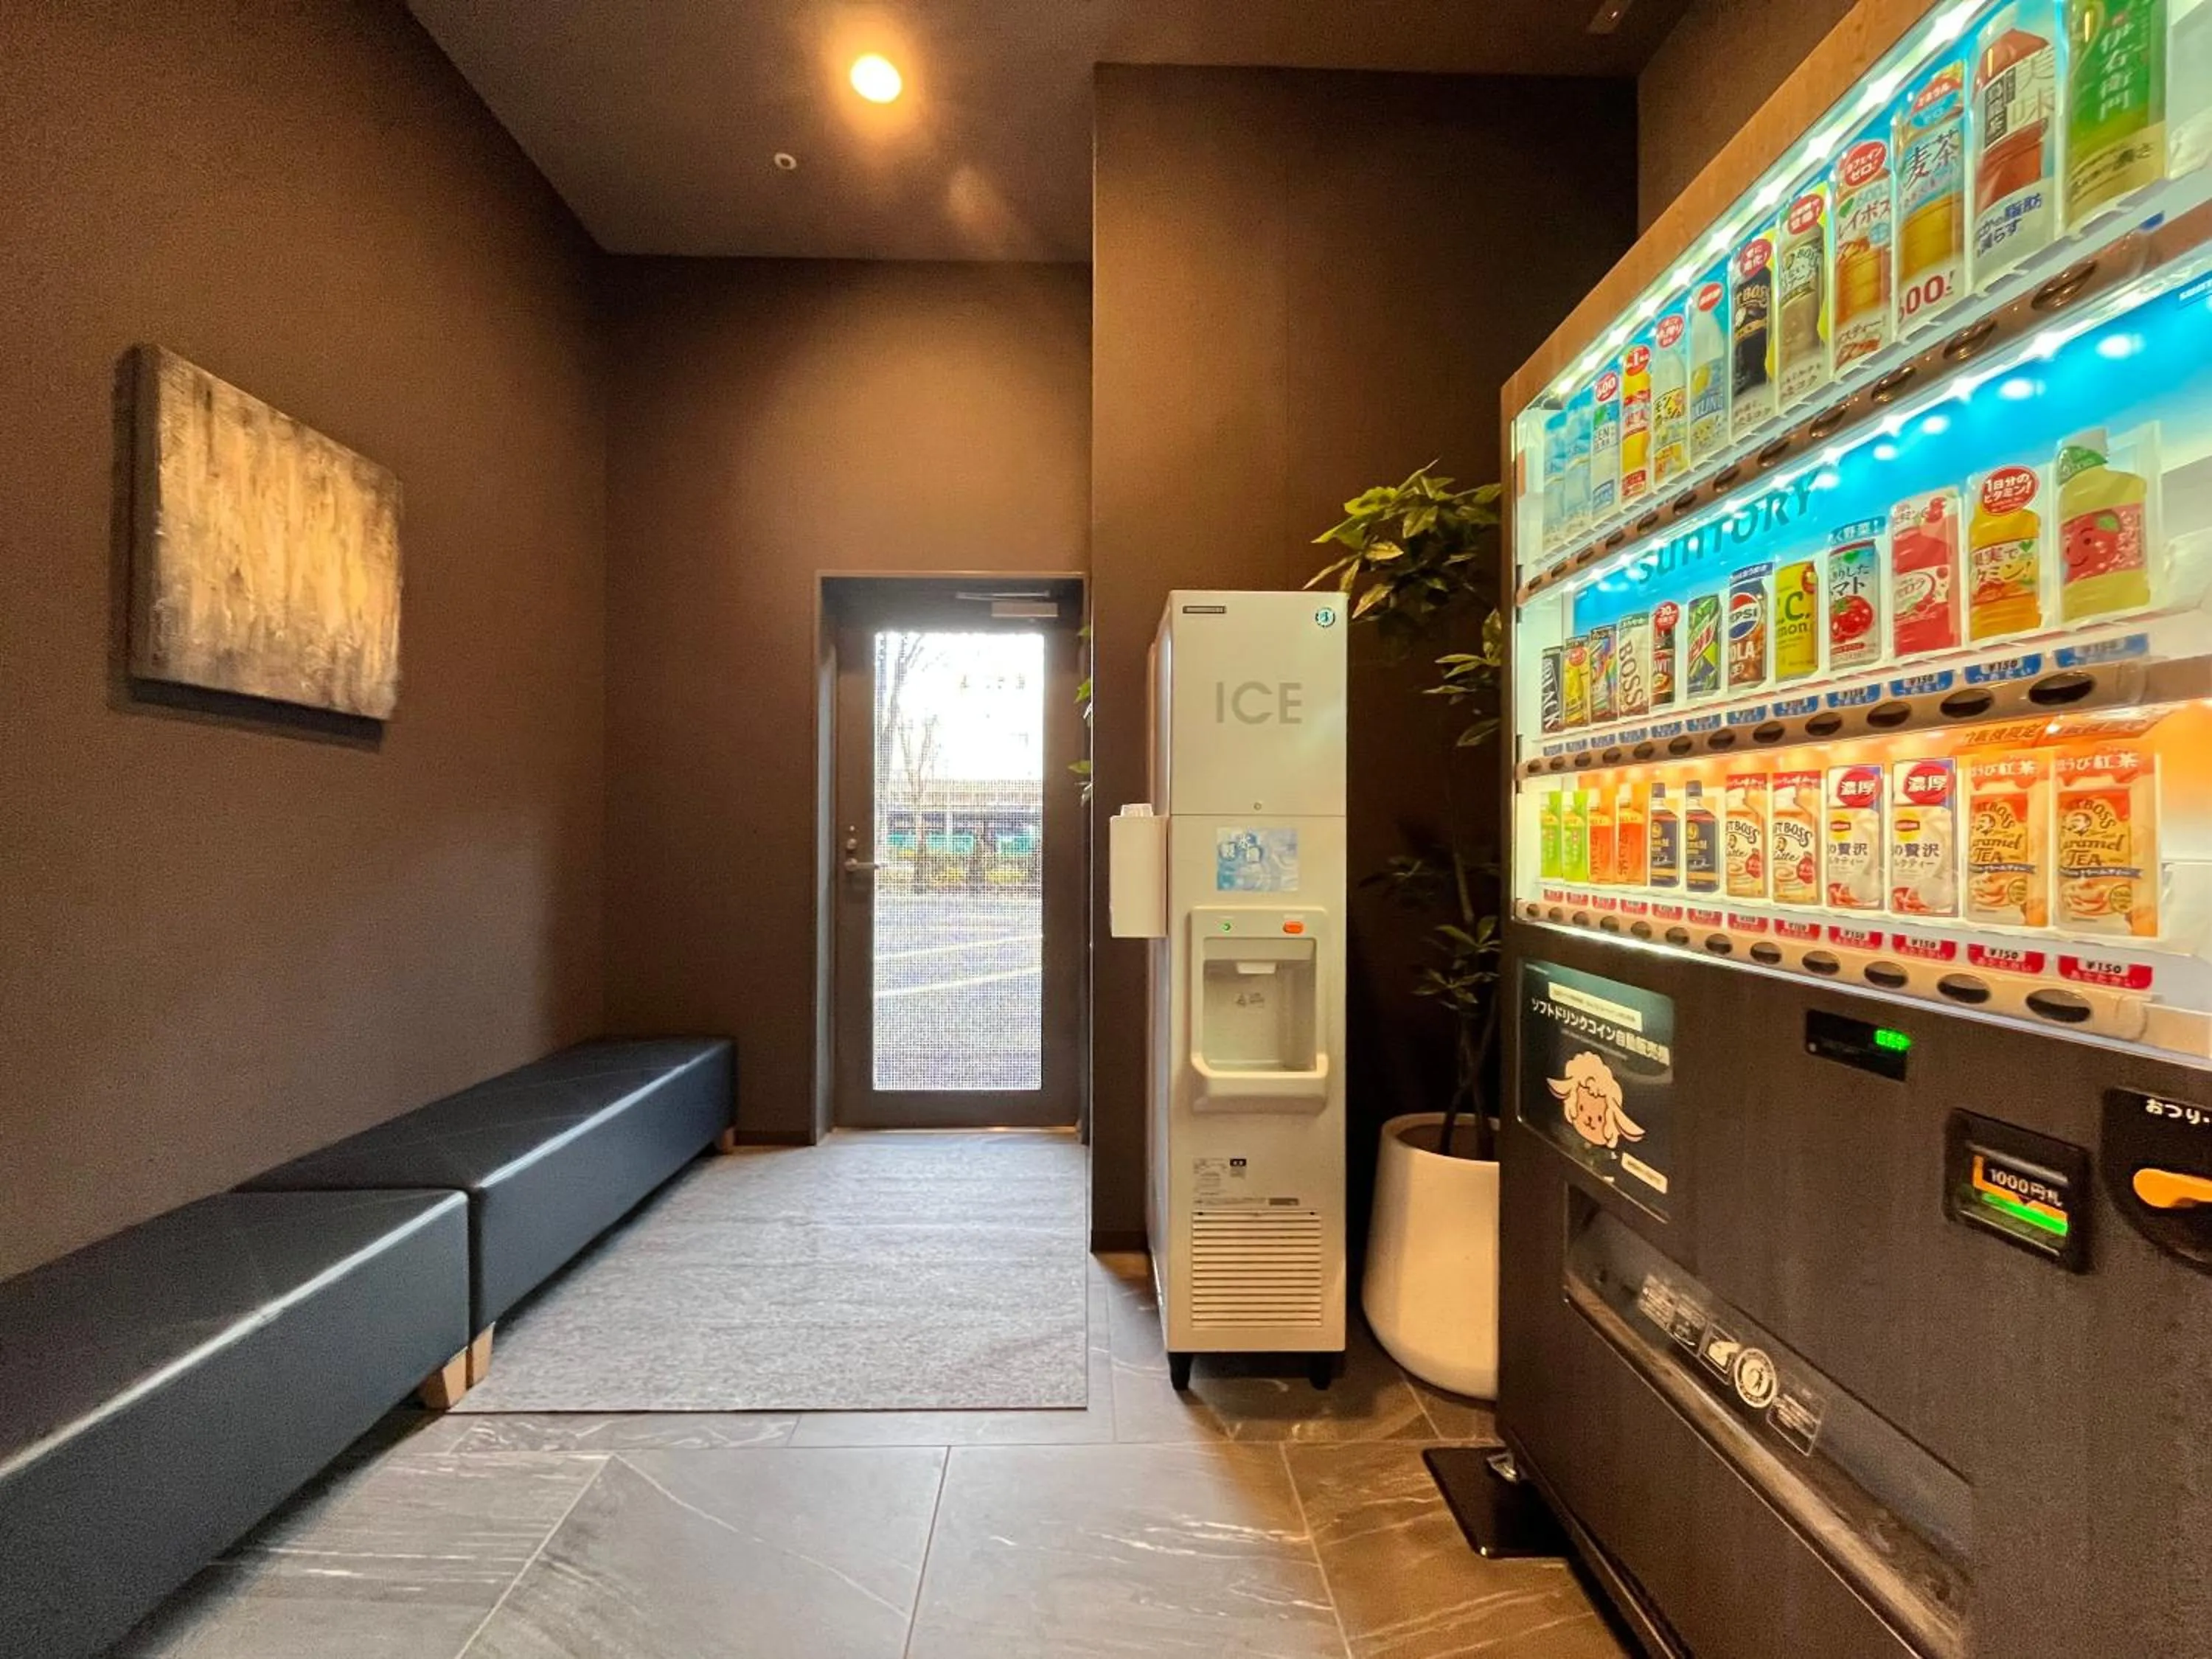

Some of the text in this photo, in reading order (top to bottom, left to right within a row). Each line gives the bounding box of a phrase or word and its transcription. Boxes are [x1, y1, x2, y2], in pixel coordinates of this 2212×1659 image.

[1985, 473, 2030, 493] 1日分の
[1619, 640, 1644, 706] BOSS
[1216, 681, 1302, 725] ICE
[1840, 781, 1876, 796] 濃厚
[1908, 775, 1947, 792] 濃厚
[1784, 822, 1813, 848] BOSS
[2067, 849, 2101, 866] TEA
[1989, 947, 2019, 959] ¥150
[2086, 961, 2122, 974] ¥150
